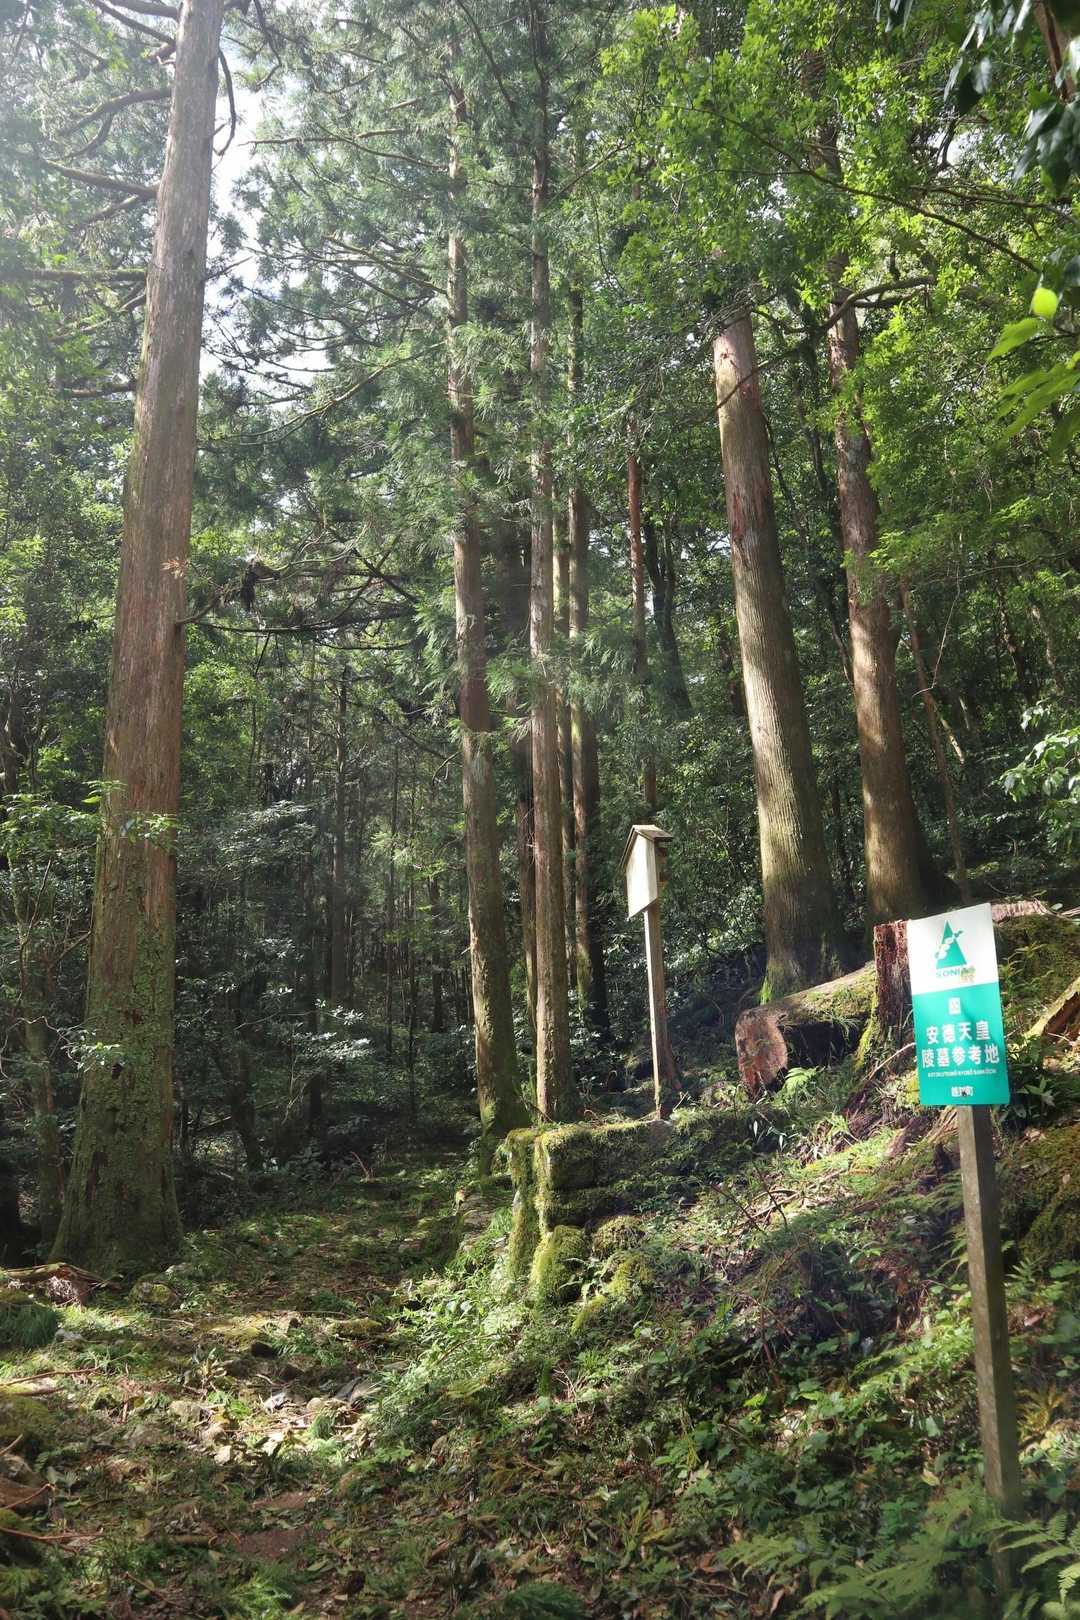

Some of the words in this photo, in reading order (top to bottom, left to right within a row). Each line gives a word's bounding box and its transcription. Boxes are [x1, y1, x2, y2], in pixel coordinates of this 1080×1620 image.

[926, 1020, 991, 1044] 安徳天皇
[921, 1043, 1000, 1069] 陵墓参考地
